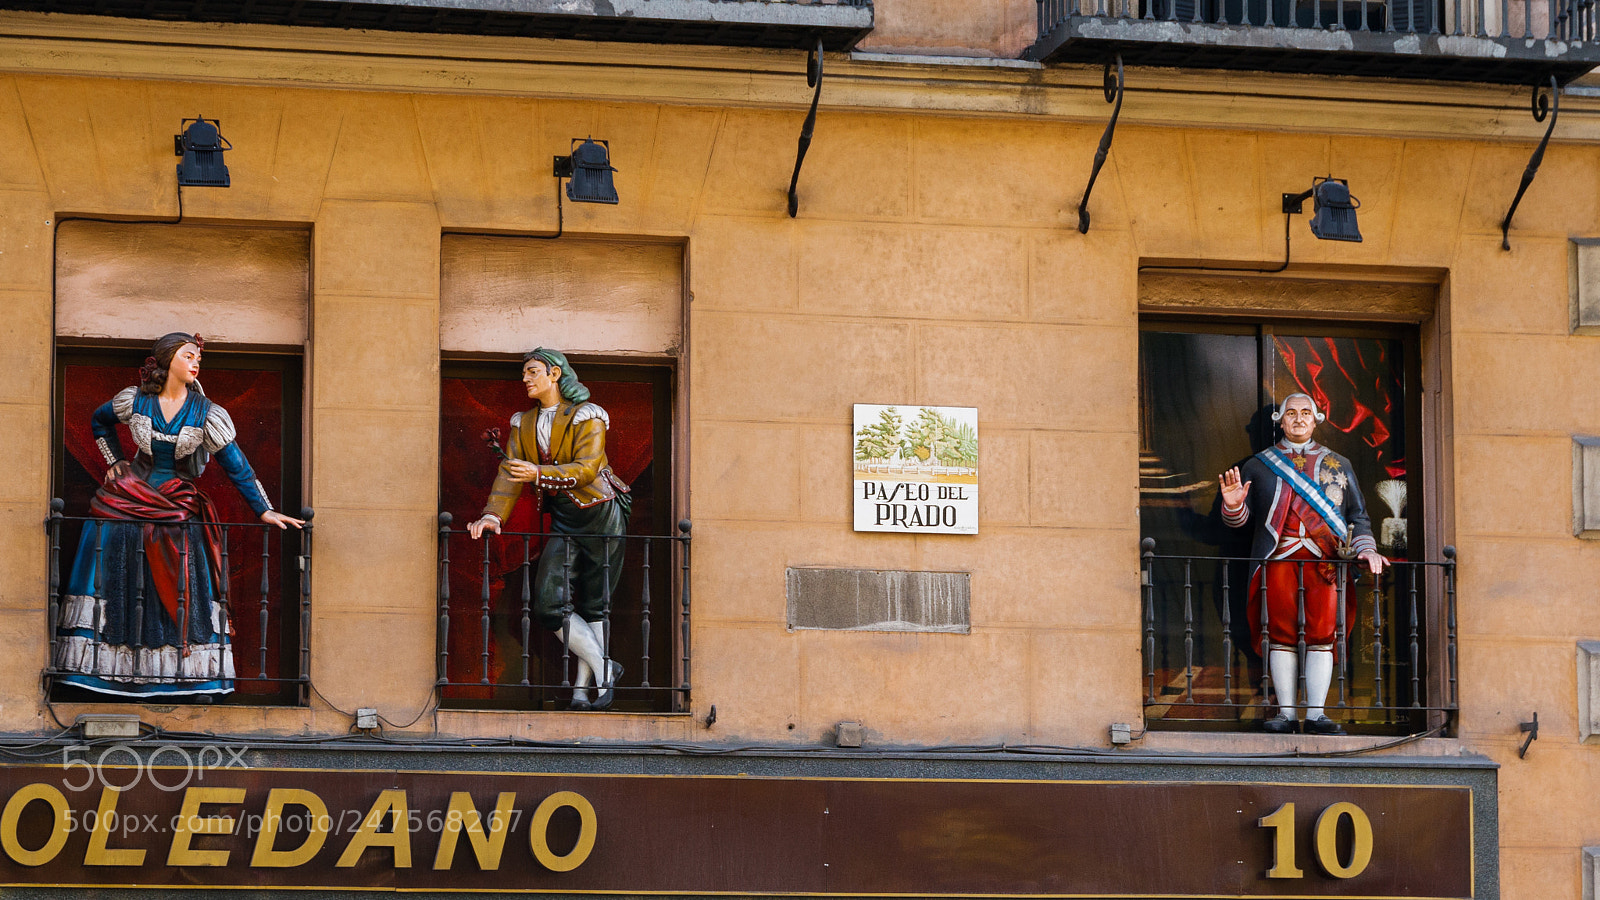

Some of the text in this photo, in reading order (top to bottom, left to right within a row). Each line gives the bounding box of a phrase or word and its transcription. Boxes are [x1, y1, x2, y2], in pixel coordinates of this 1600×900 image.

[863, 482, 969, 502] PASEO DEL
[874, 503, 957, 528] PRADO
[0, 783, 598, 873] OLEDANO
[1258, 801, 1374, 879] 10
